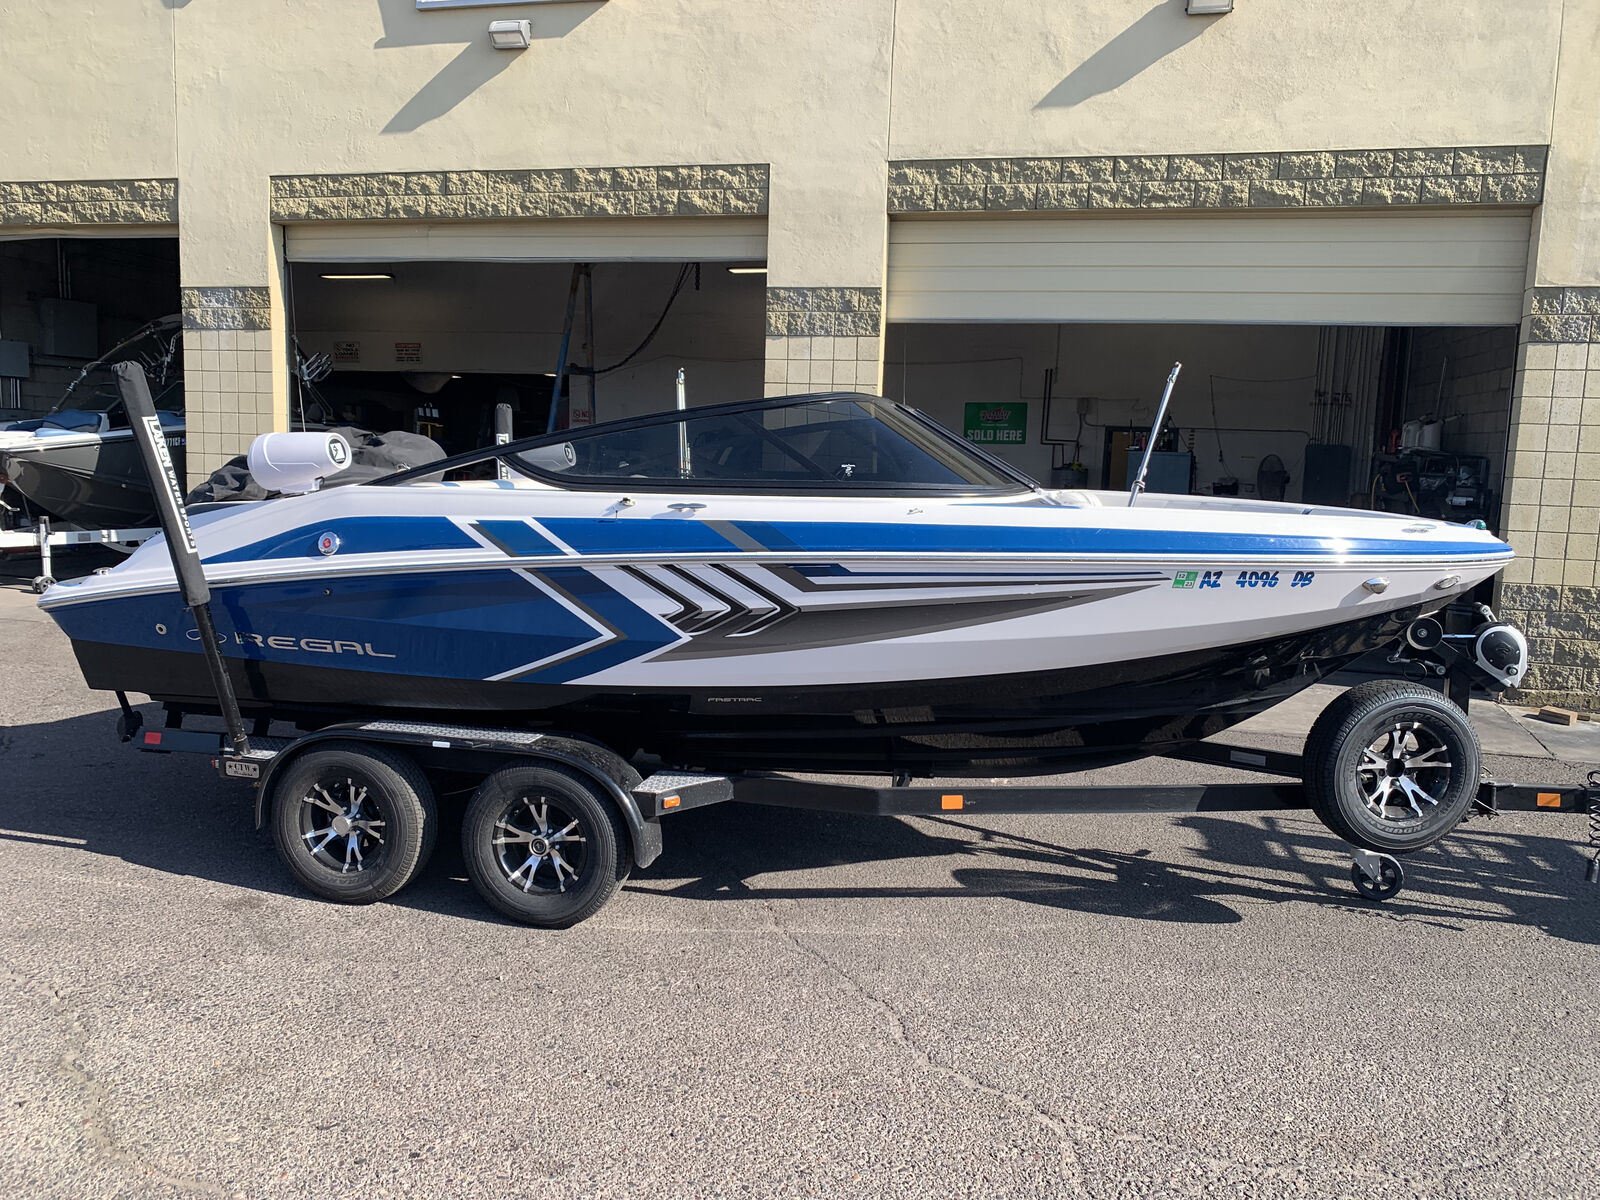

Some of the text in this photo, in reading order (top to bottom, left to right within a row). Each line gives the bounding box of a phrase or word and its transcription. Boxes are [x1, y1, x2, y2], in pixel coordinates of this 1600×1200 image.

[967, 429, 1023, 441] SOLD HERE
[148, 419, 196, 547] LAKEN WATER SPORTS
[1199, 571, 1315, 589] AZ 4096 DB
[234, 631, 396, 658] REGAL
